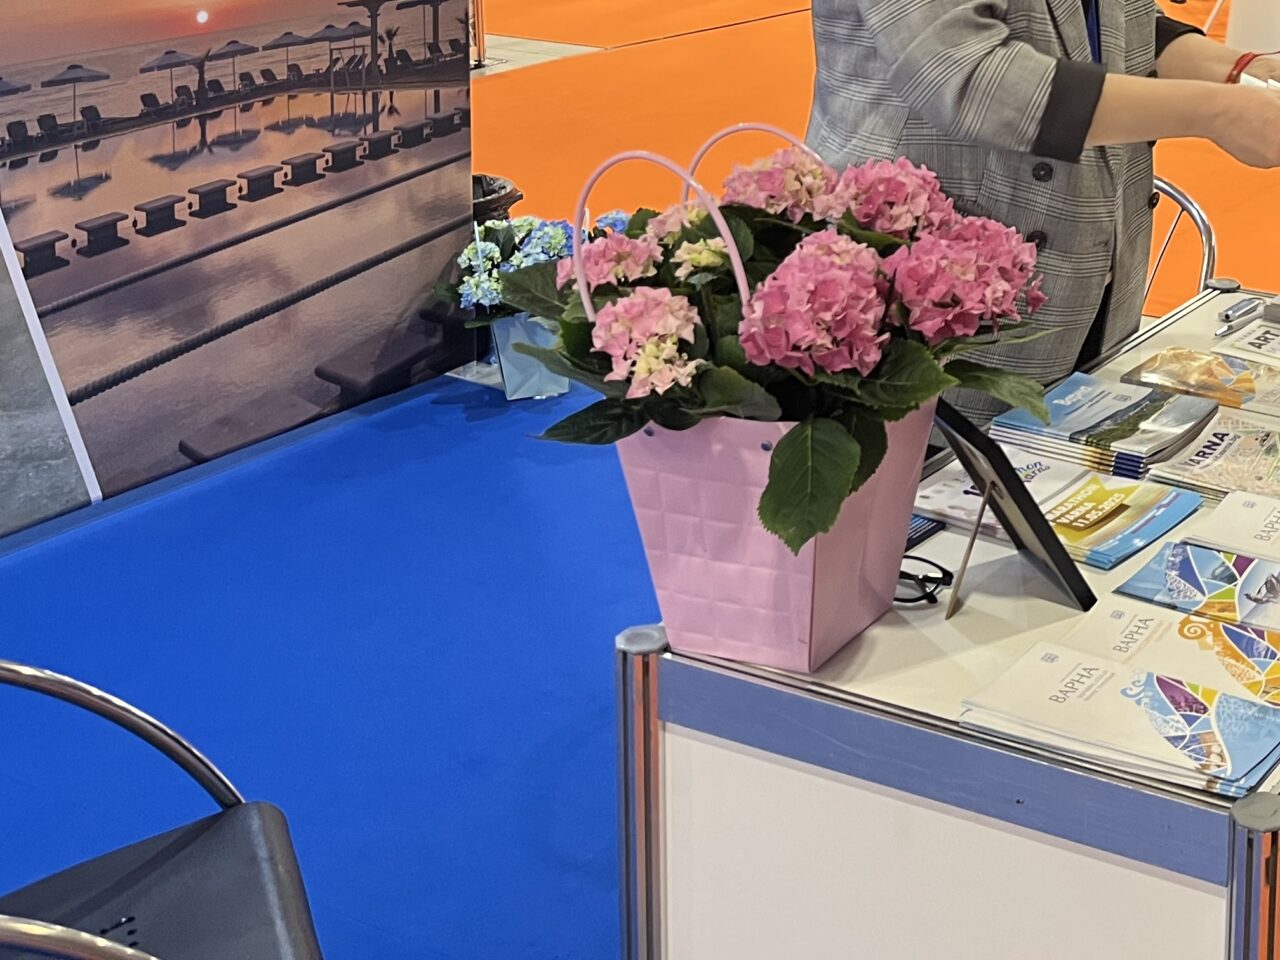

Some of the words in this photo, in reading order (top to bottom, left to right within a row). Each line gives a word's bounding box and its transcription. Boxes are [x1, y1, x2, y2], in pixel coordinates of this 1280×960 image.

[1247, 329, 1280, 350] ART
[1178, 431, 1230, 467] VARNA
[1055, 502, 1097, 524] VARNA
[1071, 492, 1126, 528] 11.05.2025
[1112, 617, 1155, 654] ВАРНА
[1048, 665, 1100, 704] ВАРНА
